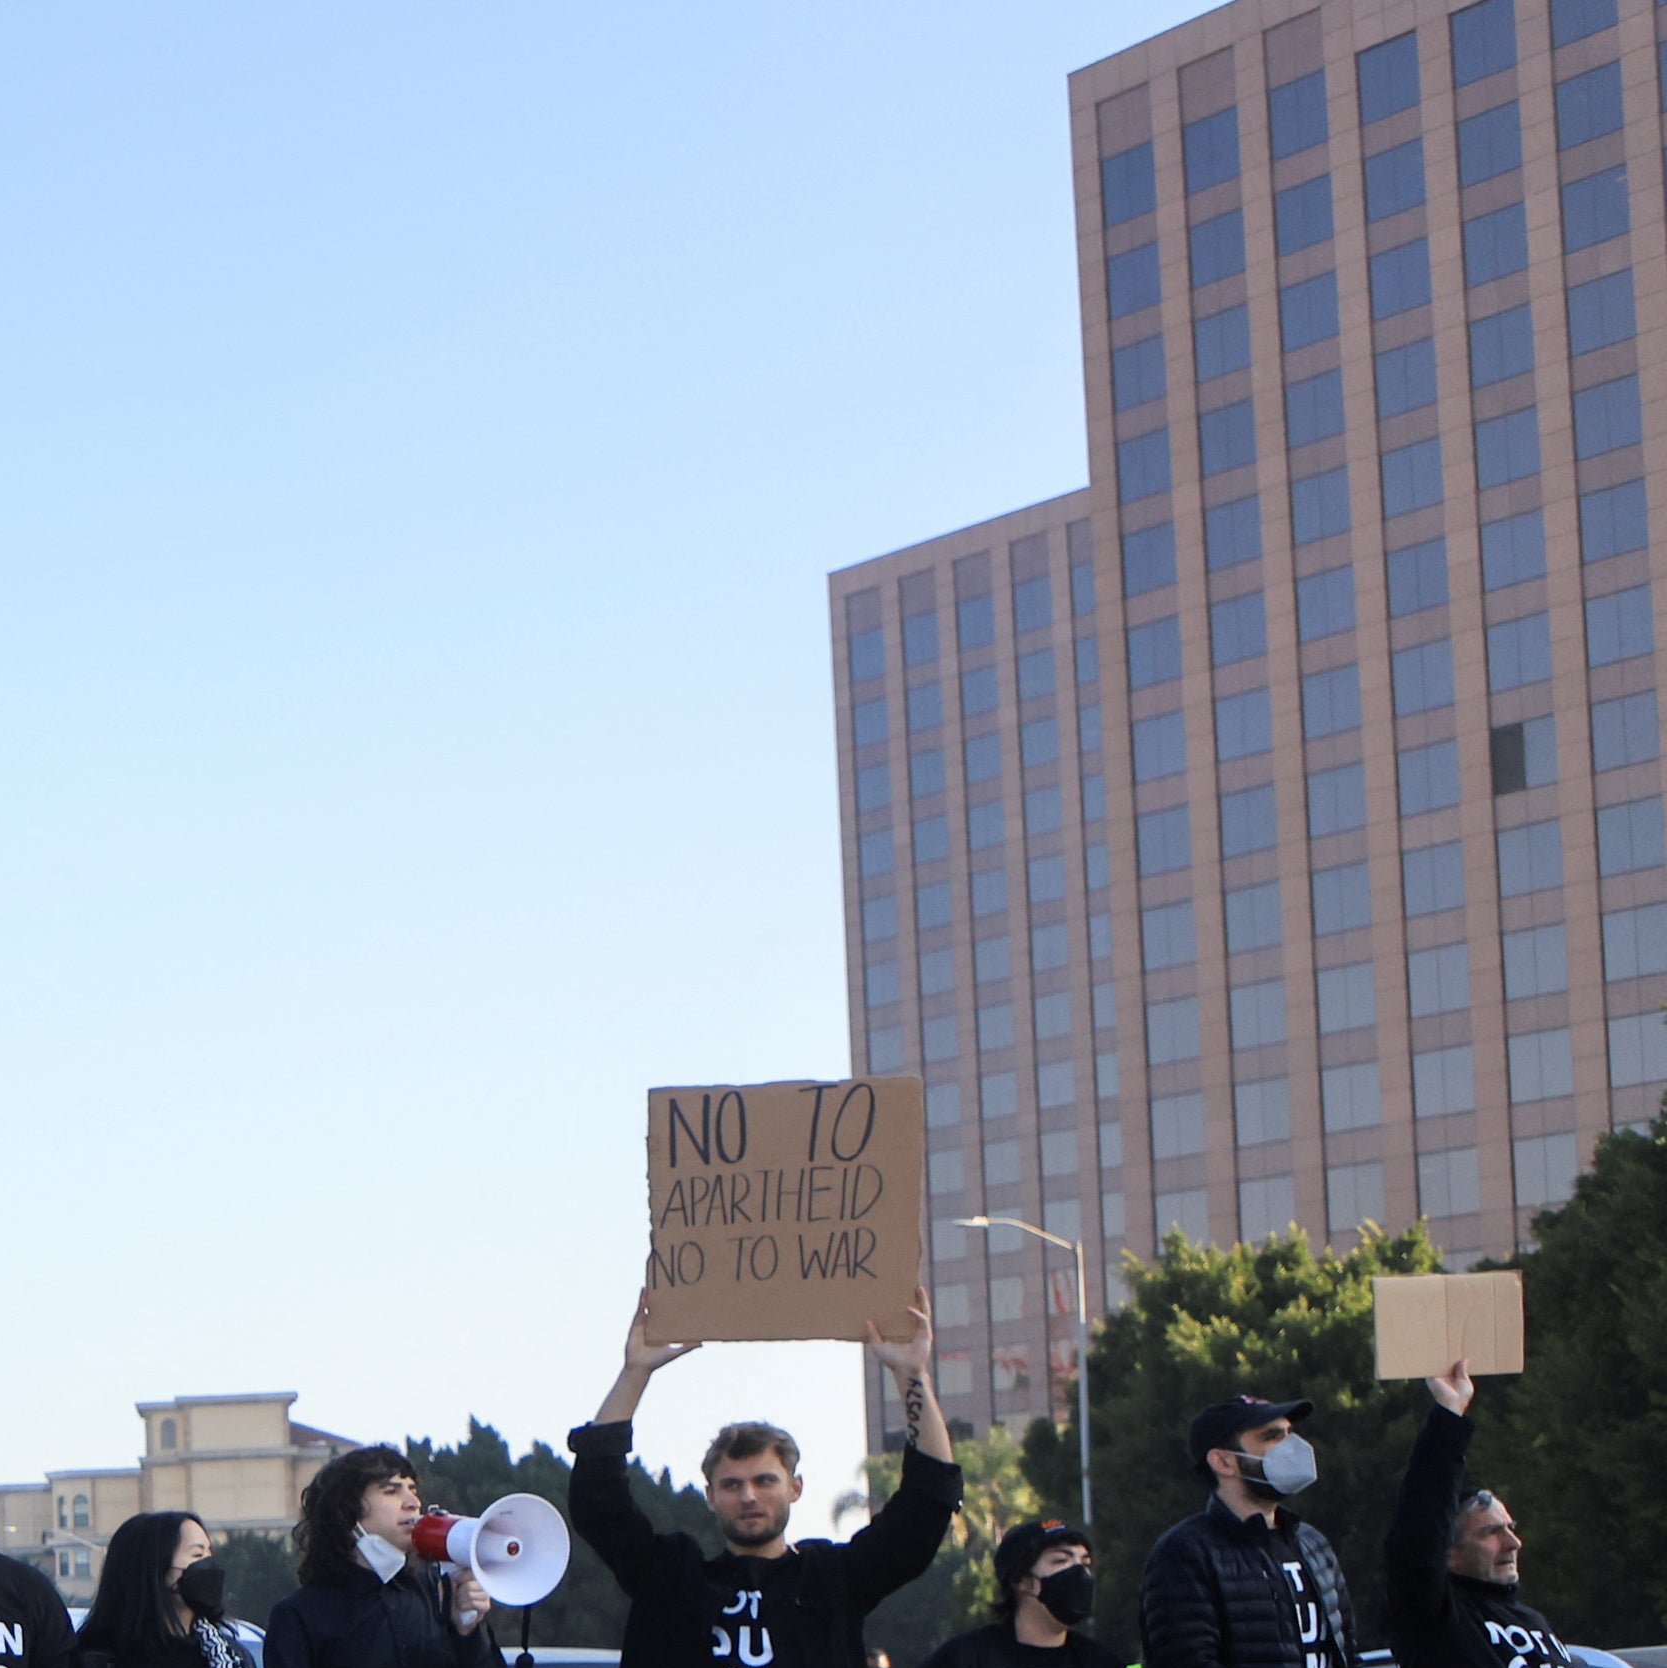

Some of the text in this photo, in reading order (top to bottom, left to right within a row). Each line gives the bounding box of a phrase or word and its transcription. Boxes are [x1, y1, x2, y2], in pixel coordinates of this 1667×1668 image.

[669, 1083, 876, 1168] NO TO
[660, 1164, 883, 1229] APARTHEID
[650, 1228, 877, 1290] NO TO WAR
[1484, 1620, 1549, 1655] NOT
